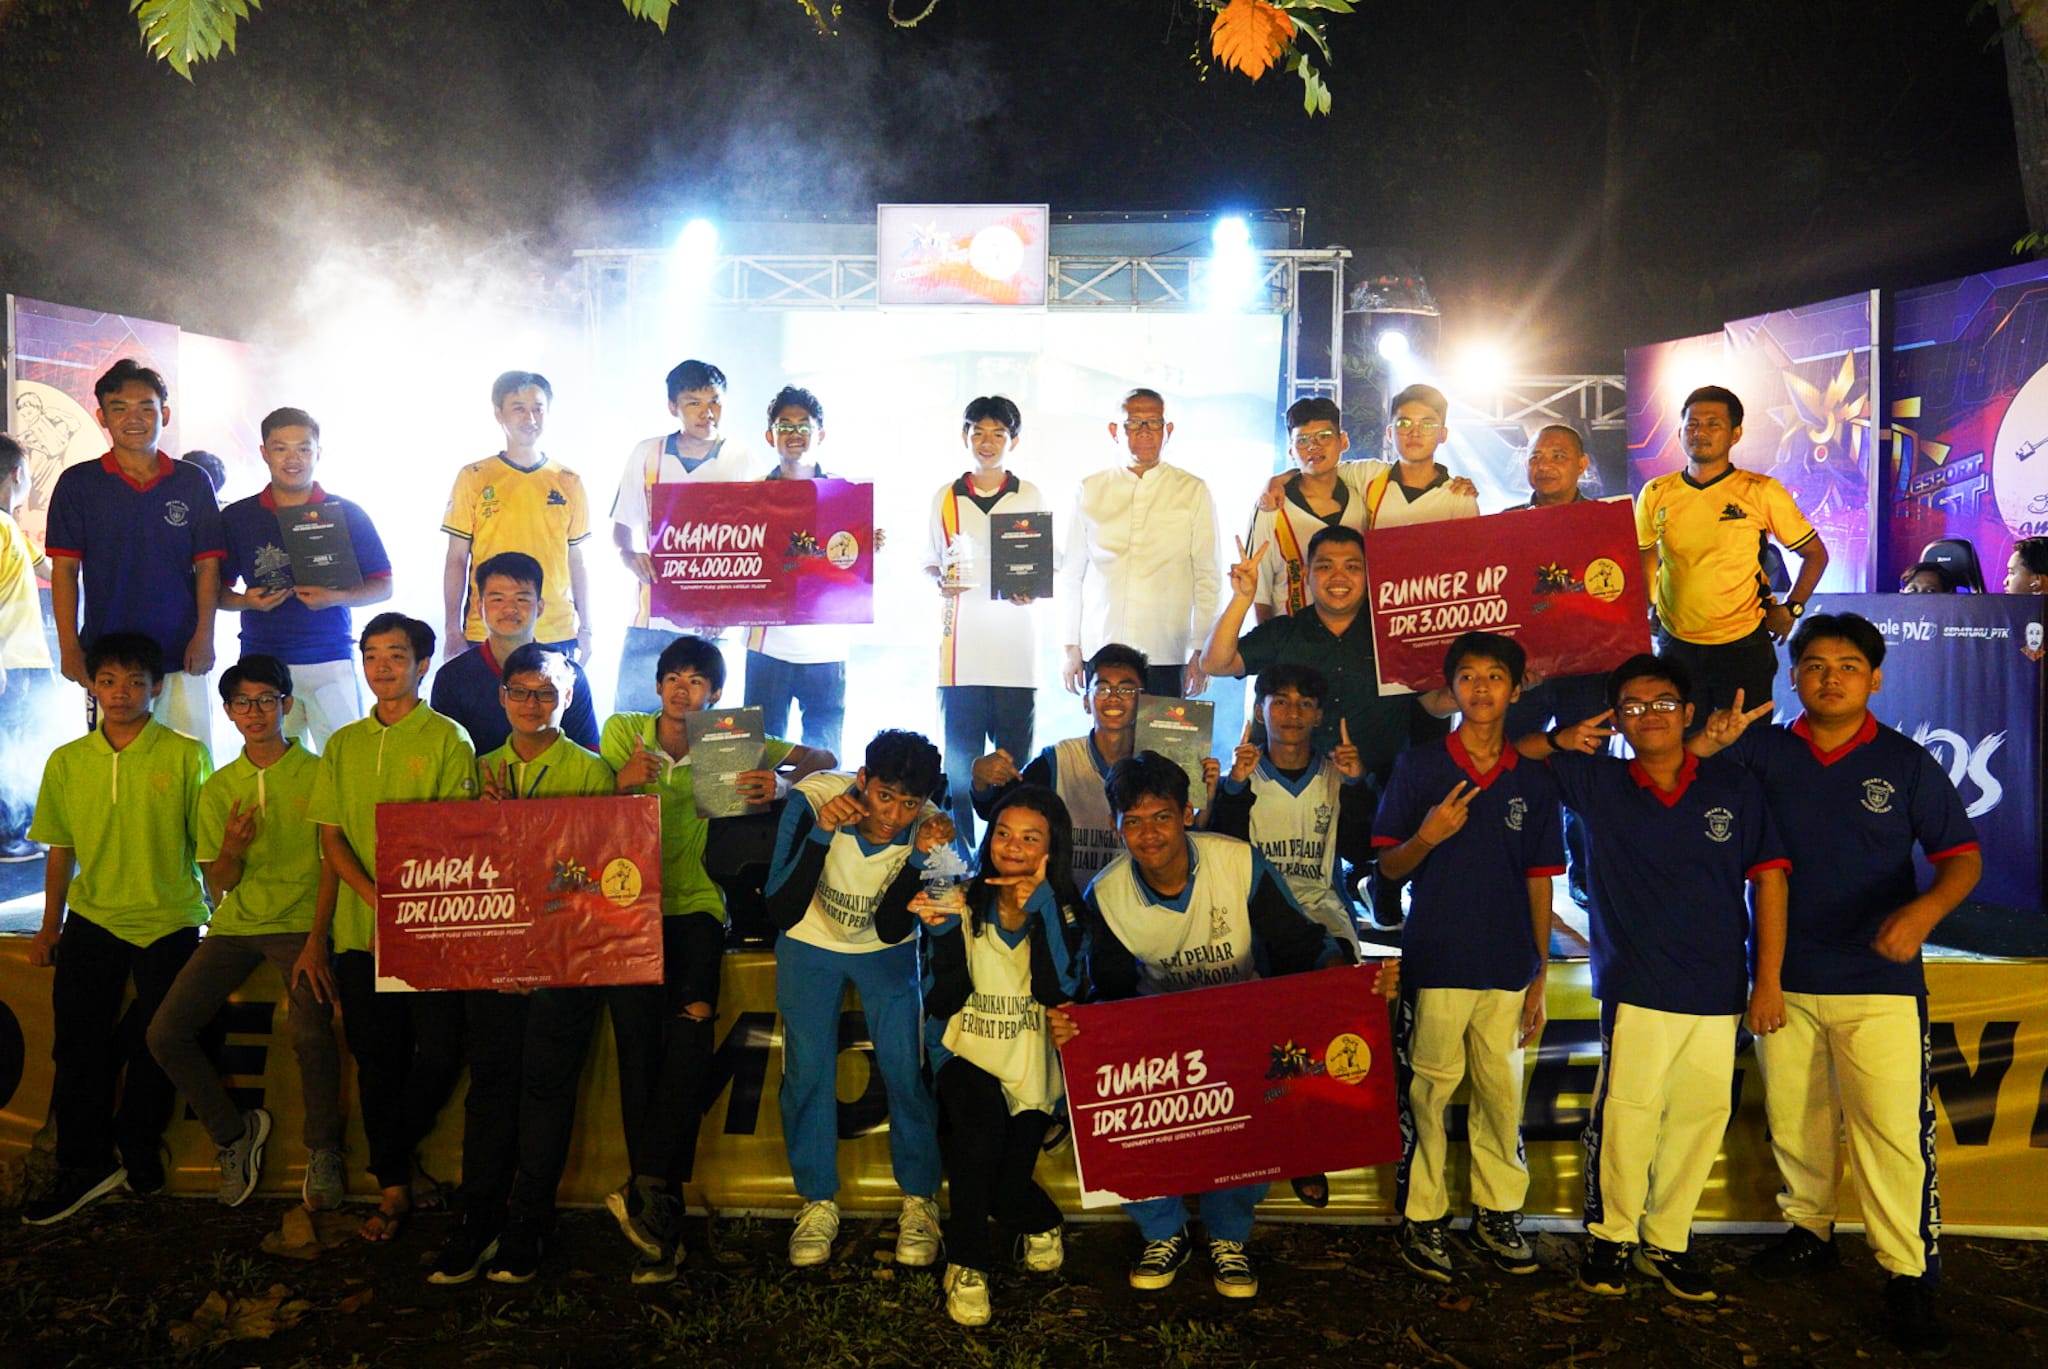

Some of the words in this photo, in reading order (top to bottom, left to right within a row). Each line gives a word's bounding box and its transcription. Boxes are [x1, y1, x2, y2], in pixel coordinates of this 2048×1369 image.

[1911, 453, 1983, 492] ESPORT
[662, 521, 768, 552] CHAMPION
[661, 560, 685, 577] IDR
[690, 556, 763, 577] 4.000.000
[1379, 571, 1468, 608] RUNNER
[1477, 565, 1508, 594] UP
[1388, 614, 1416, 637] IDR
[1420, 600, 1508, 633] 3.000.000
[400, 856, 475, 890] JUARA
[478, 856, 500, 888] 4
[395, 902, 426, 925] IDR
[429, 894, 516, 921] 1.000.000
[1097, 1052, 1179, 1097] JUARA
[1183, 1050, 1208, 1084] 3
[1092, 1108, 1127, 1137] IDR
[1131, 1086, 1234, 1132] 2.000.000
